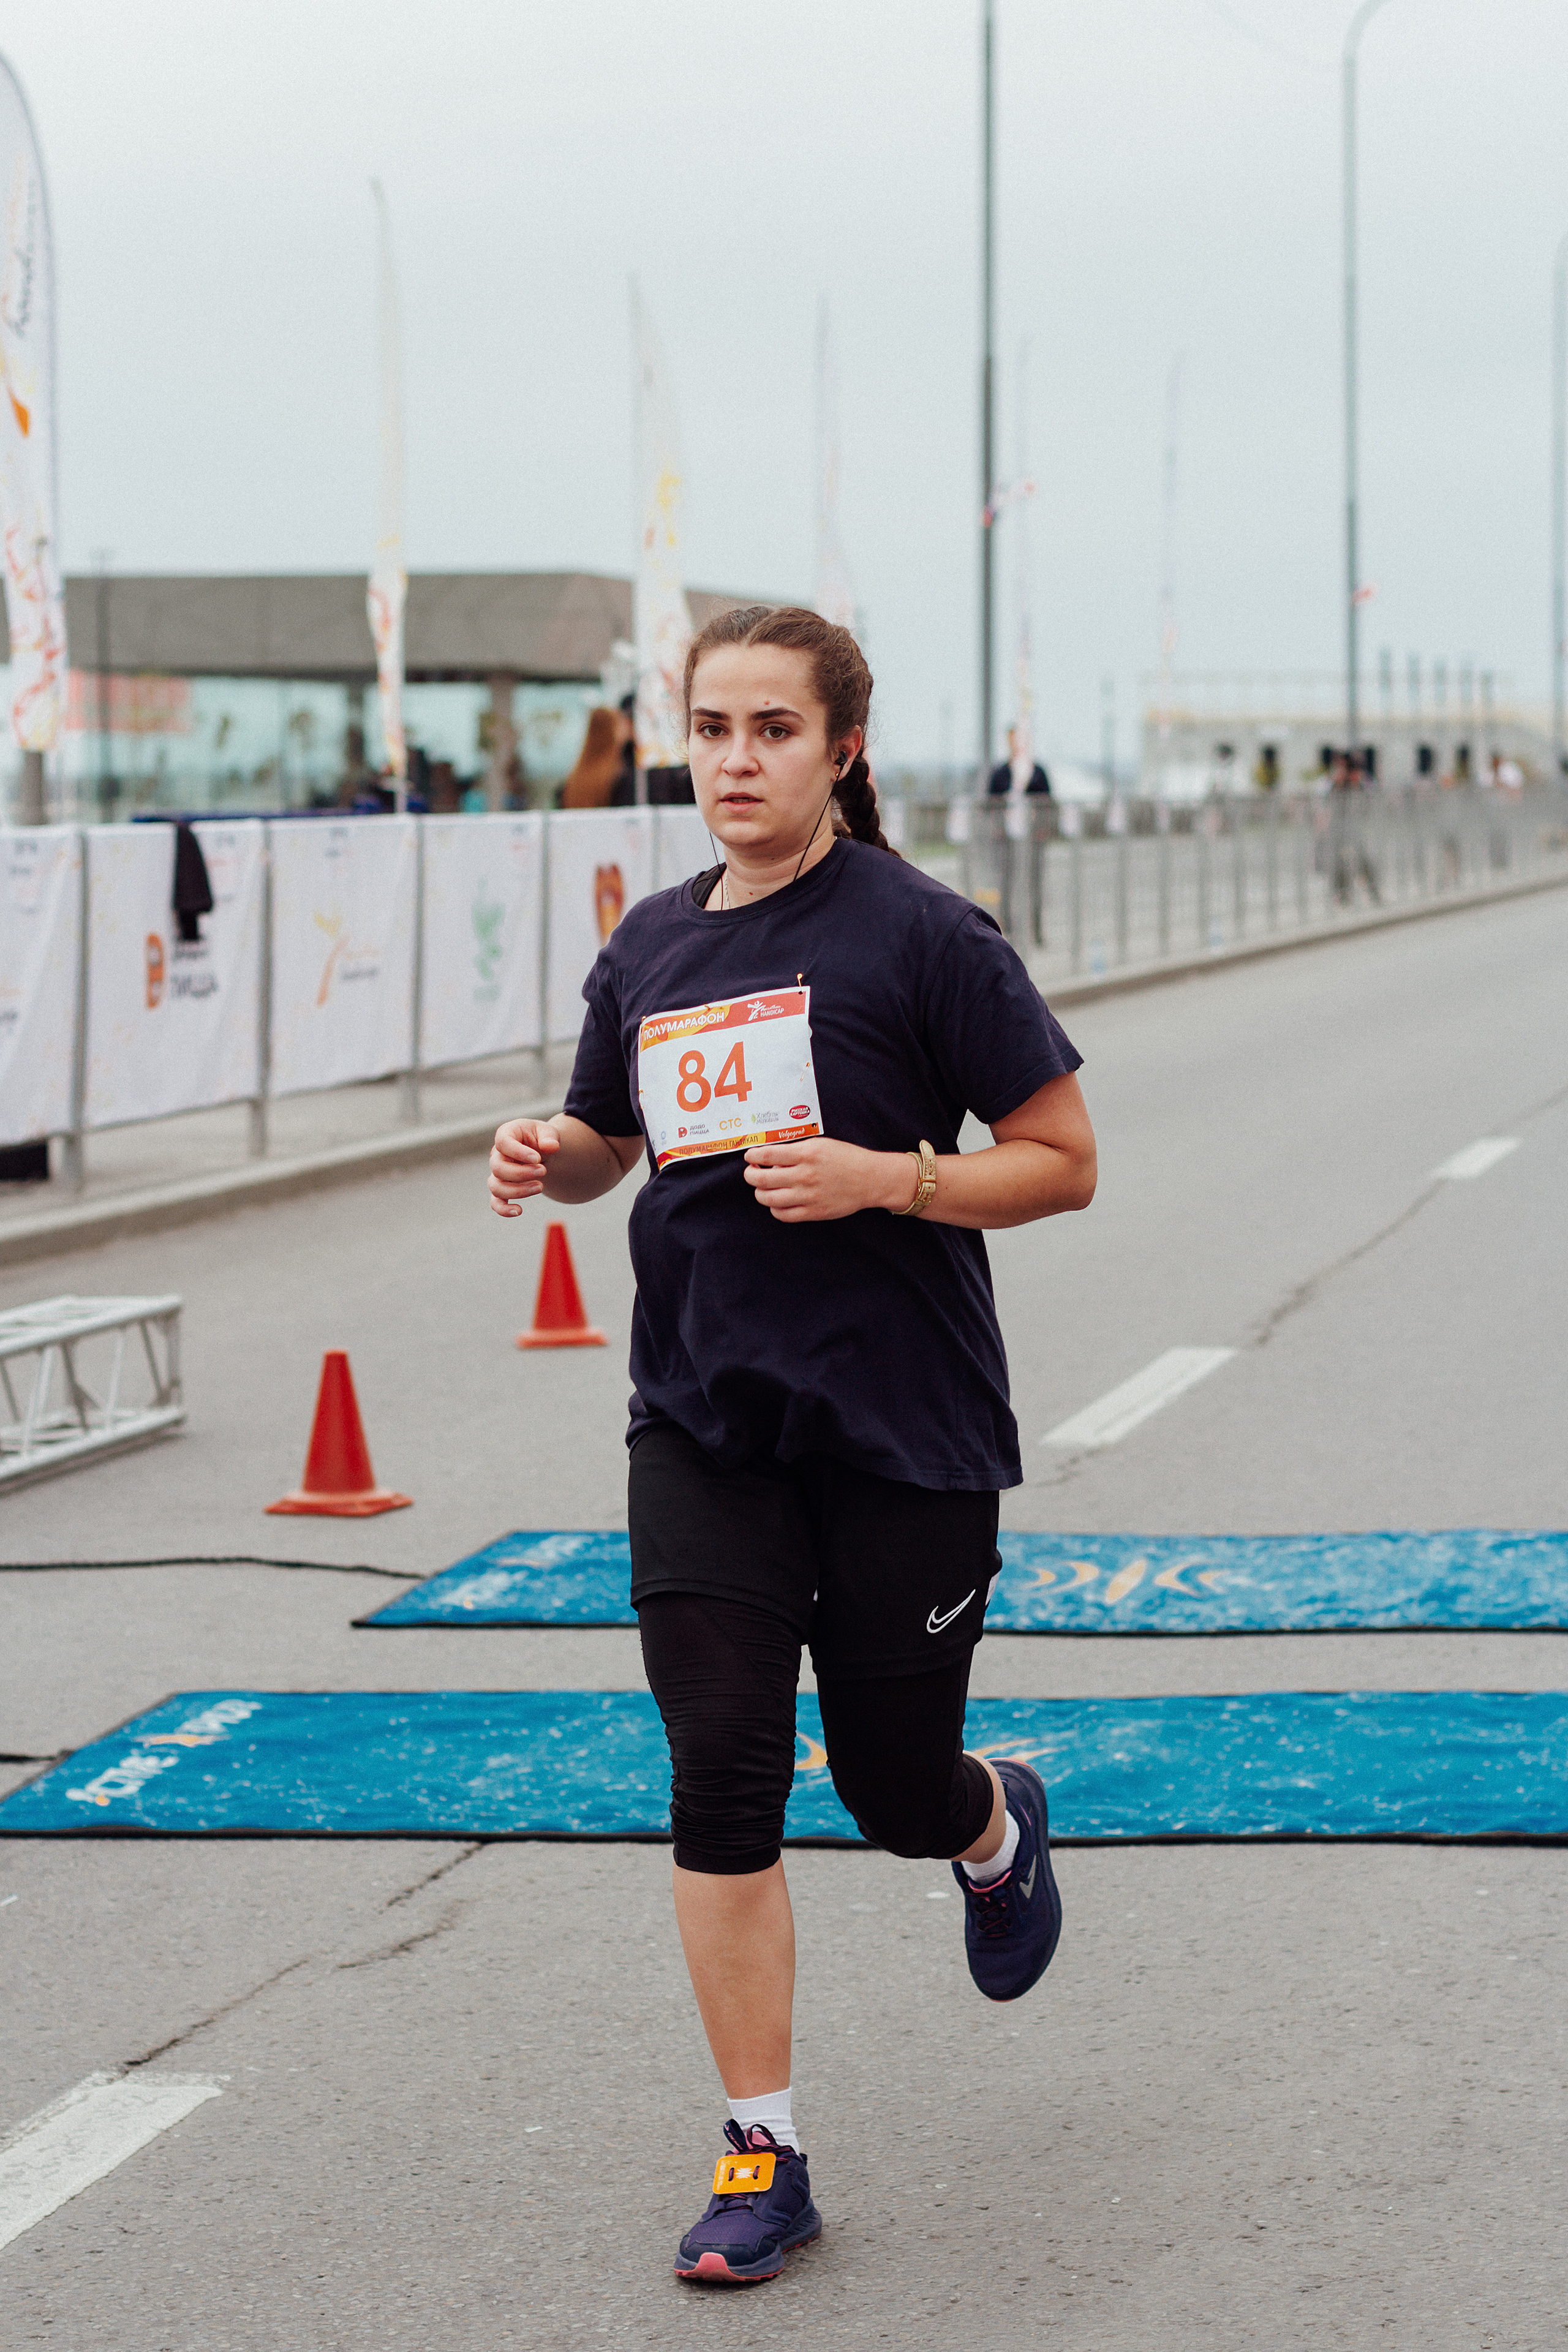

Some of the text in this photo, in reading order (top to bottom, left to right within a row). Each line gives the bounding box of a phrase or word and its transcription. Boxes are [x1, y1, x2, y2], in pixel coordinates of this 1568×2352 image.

[761, 1008, 785, 1017] HANDICAP
[644, 1011, 725, 1041] ПОЛУМАРАФОН
[676, 1041, 752, 1112] 84
[719, 1117, 742, 1130] СТС
[778, 1127, 805, 1139] Volgograd
[729, 1136, 758, 1147] ГАНДИКАП
